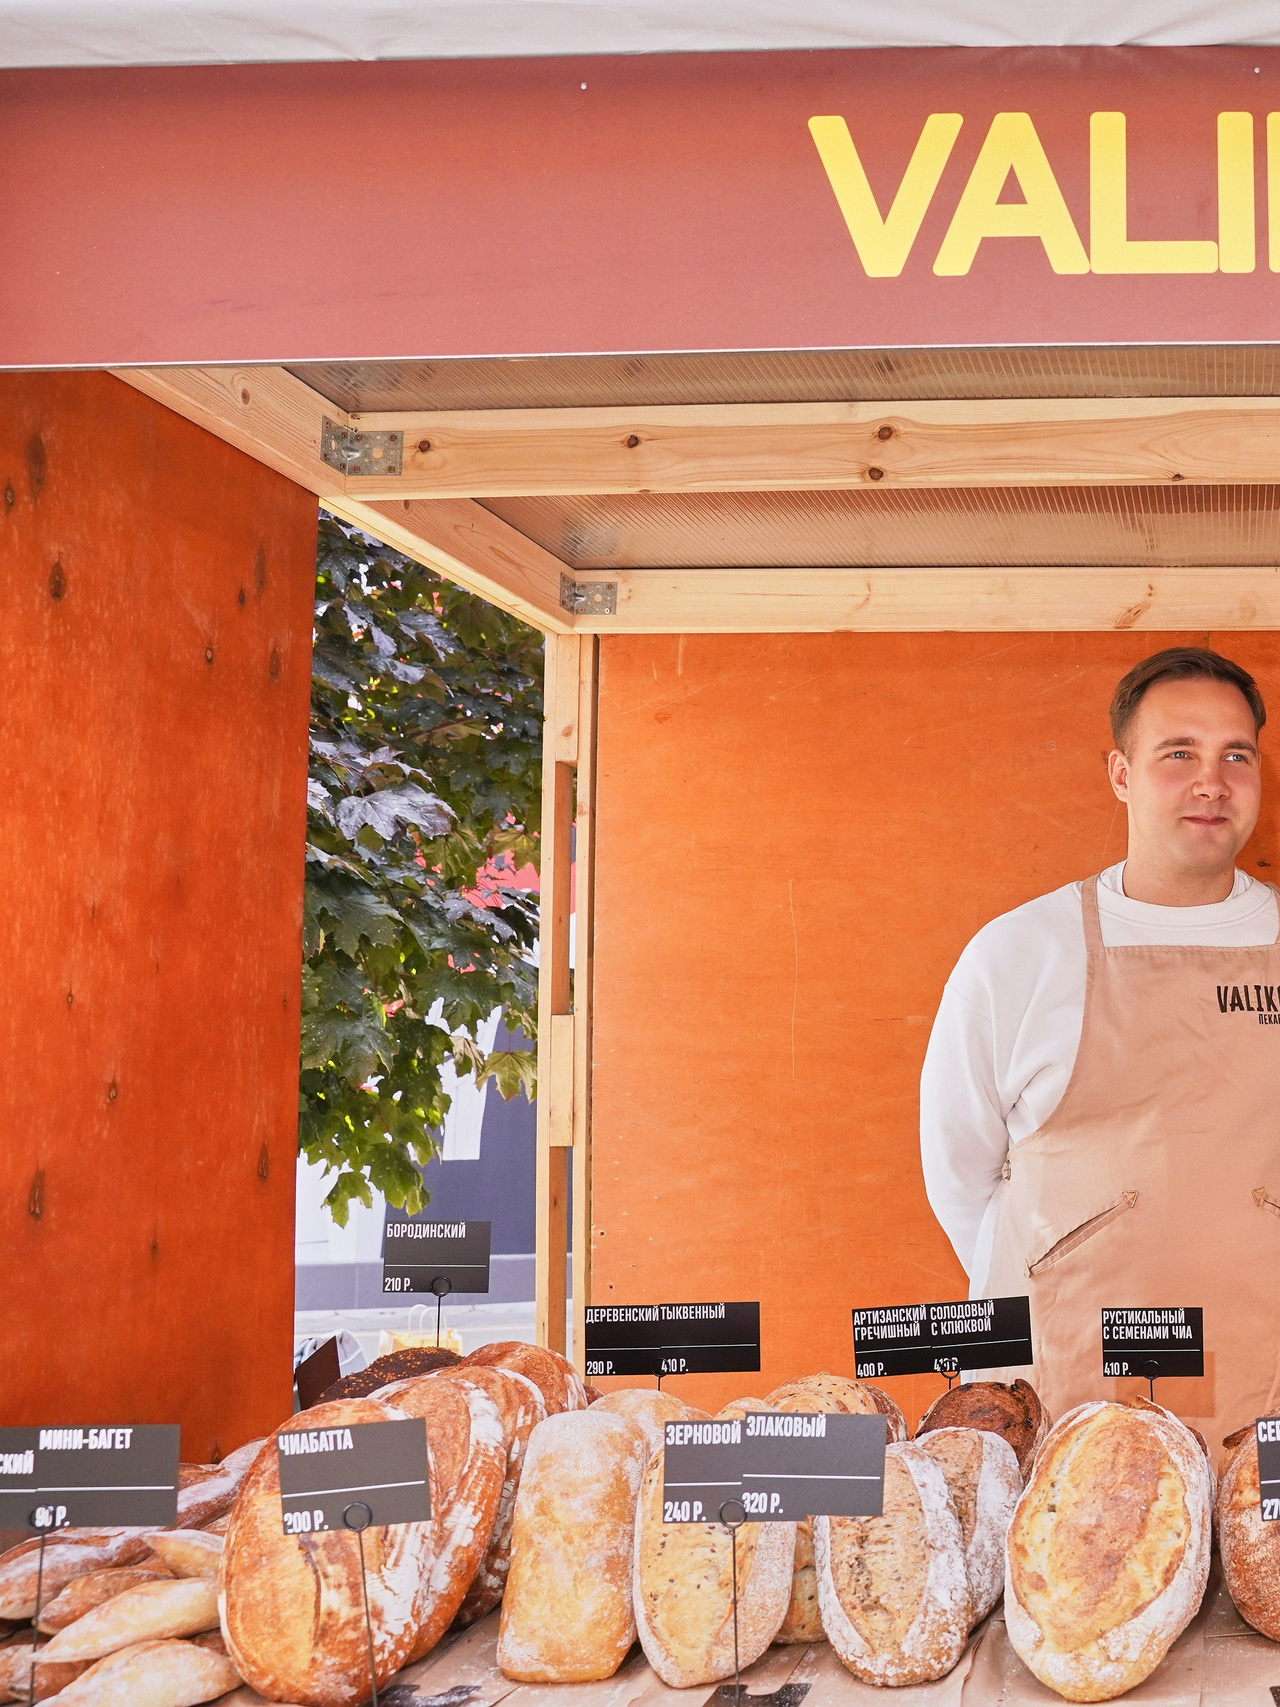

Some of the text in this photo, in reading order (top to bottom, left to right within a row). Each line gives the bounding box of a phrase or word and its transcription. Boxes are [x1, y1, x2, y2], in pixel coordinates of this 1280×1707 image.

[386, 1221, 466, 1239] БОРОДИНСКИЙ
[384, 1277, 414, 1292] 210 Р.
[585, 1305, 660, 1324] ДЕРЕВЕНСКИЙ
[660, 1302, 726, 1320] ТЫКВЕННЫЙ
[853, 1304, 927, 1326] АРТИЗАНСКИЙ
[930, 1300, 995, 1321] СОЛОДОВЫЙ
[1102, 1307, 1185, 1325] РУСТИКАЛЬНЫЙ
[854, 1320, 921, 1341] ГРЕЧИШНЫЙ
[931, 1316, 992, 1336] С КЛЮКВОЙ
[1103, 1325, 1193, 1340] С СЕМЕНАМИ ЧИА
[586, 1360, 616, 1375] 290 Р.
[661, 1358, 689, 1373] 410 Р.
[857, 1362, 888, 1377] 400 Р.
[1104, 1362, 1132, 1376] 410 Р.
[665, 1420, 742, 1446] ЗЕРНОВОЙ
[746, 1413, 827, 1438] ЗЛАКОВЫЙ
[39, 1428, 134, 1450] МИНИ-БАГЕТ
[278, 1428, 354, 1456] ЧИАБАТТА
[663, 1501, 707, 1522] 240 Р.
[742, 1492, 784, 1514] 320 Р.
[55, 1505, 70, 1527] Р.
[283, 1509, 329, 1534] 200 Р.
